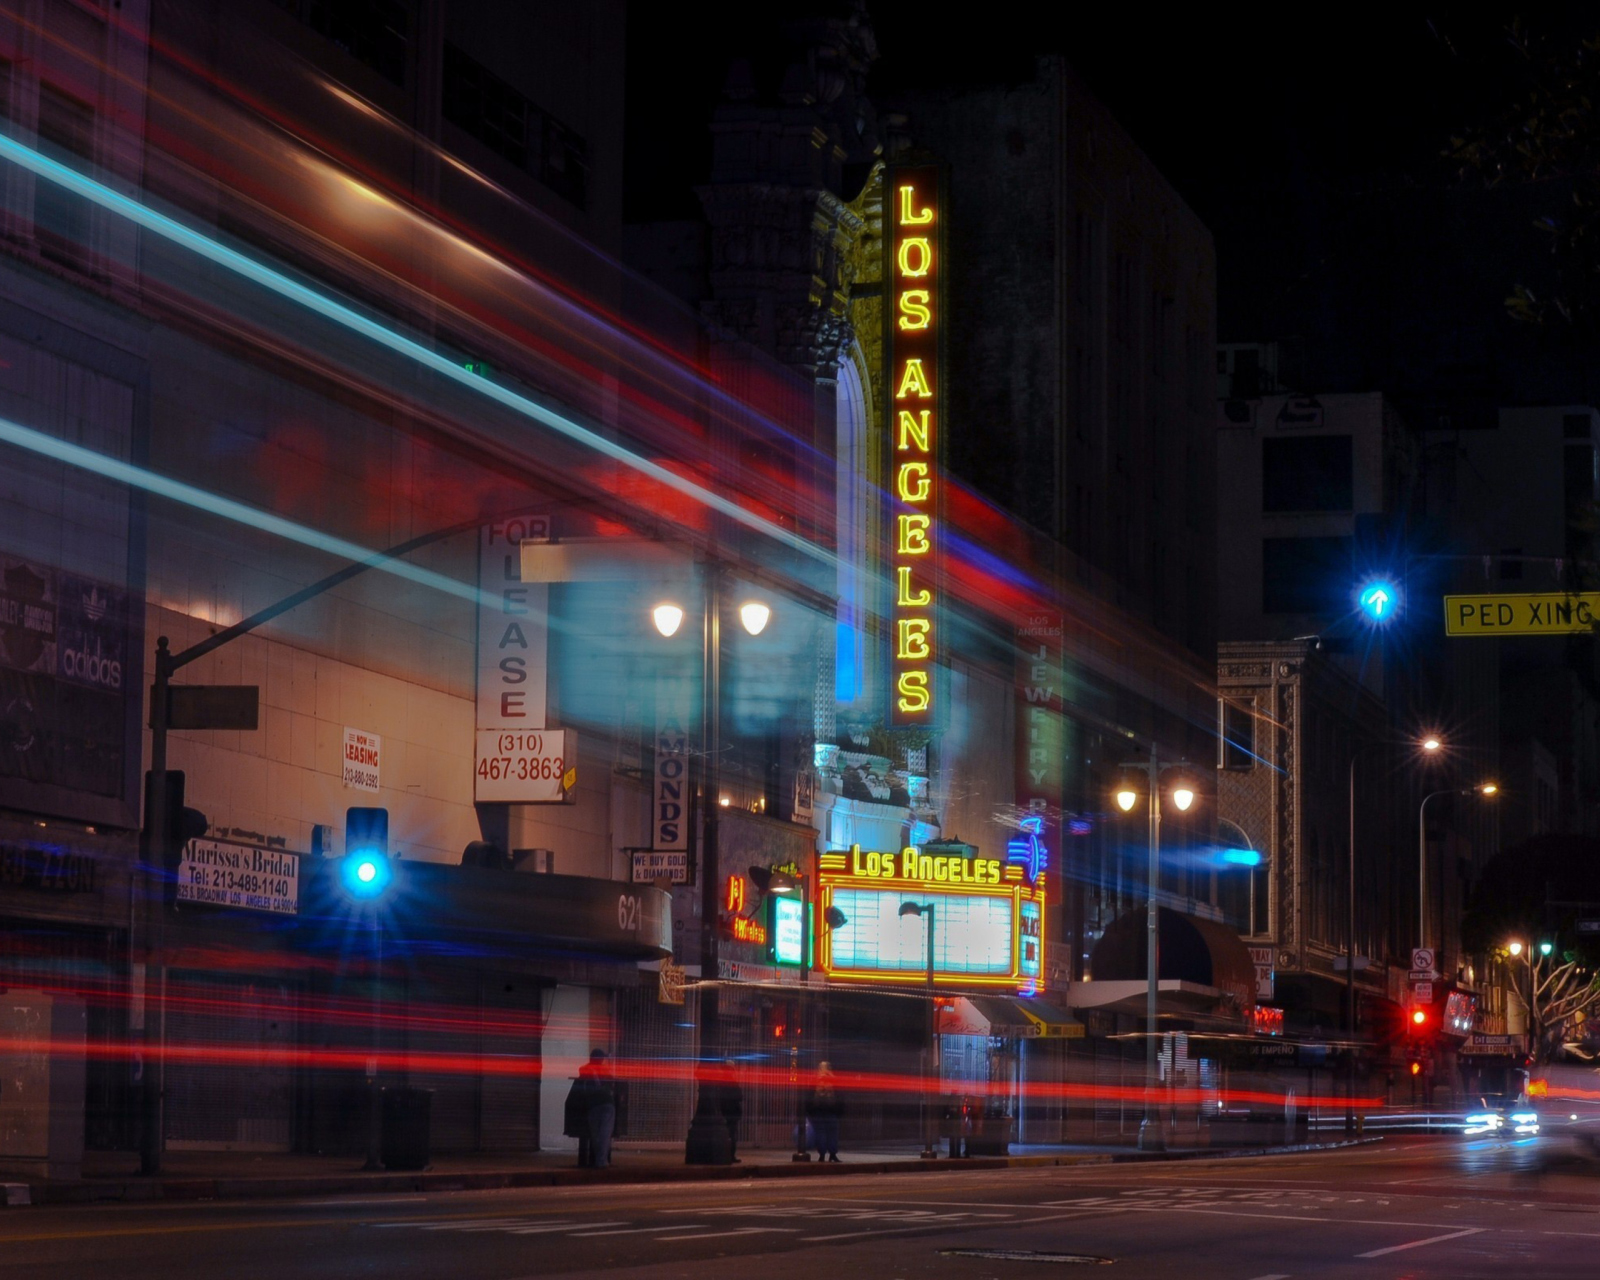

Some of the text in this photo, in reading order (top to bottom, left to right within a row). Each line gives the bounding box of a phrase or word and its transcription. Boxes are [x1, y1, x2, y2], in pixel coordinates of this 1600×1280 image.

[896, 185, 933, 713] LOS ANGELES
[488, 519, 547, 546] FOR
[1029, 616, 1048, 625] LOS
[1459, 601, 1592, 627] PED XING
[498, 554, 529, 718] LEASE
[1018, 627, 1061, 637] ANGELES
[63, 635, 122, 689] adidas
[1024, 645, 1053, 786] JEWELRY
[356, 734, 368, 746] NOW
[498, 734, 544, 755] (310)
[345, 743, 379, 768] LEASING
[477, 757, 564, 781] 467-3863
[184, 840, 296, 878] Marissa's Bridal
[634, 855, 686, 867] WE BUY GOLD
[189, 866, 289, 897] Tel: 213-489-1140
[643, 868, 685, 879] DIAMONDS
[197, 887, 228, 904] BROADWAY
[230, 892, 242, 905] LOS
[245, 894, 271, 910] ANGELES
[618, 894, 642, 931] 621
